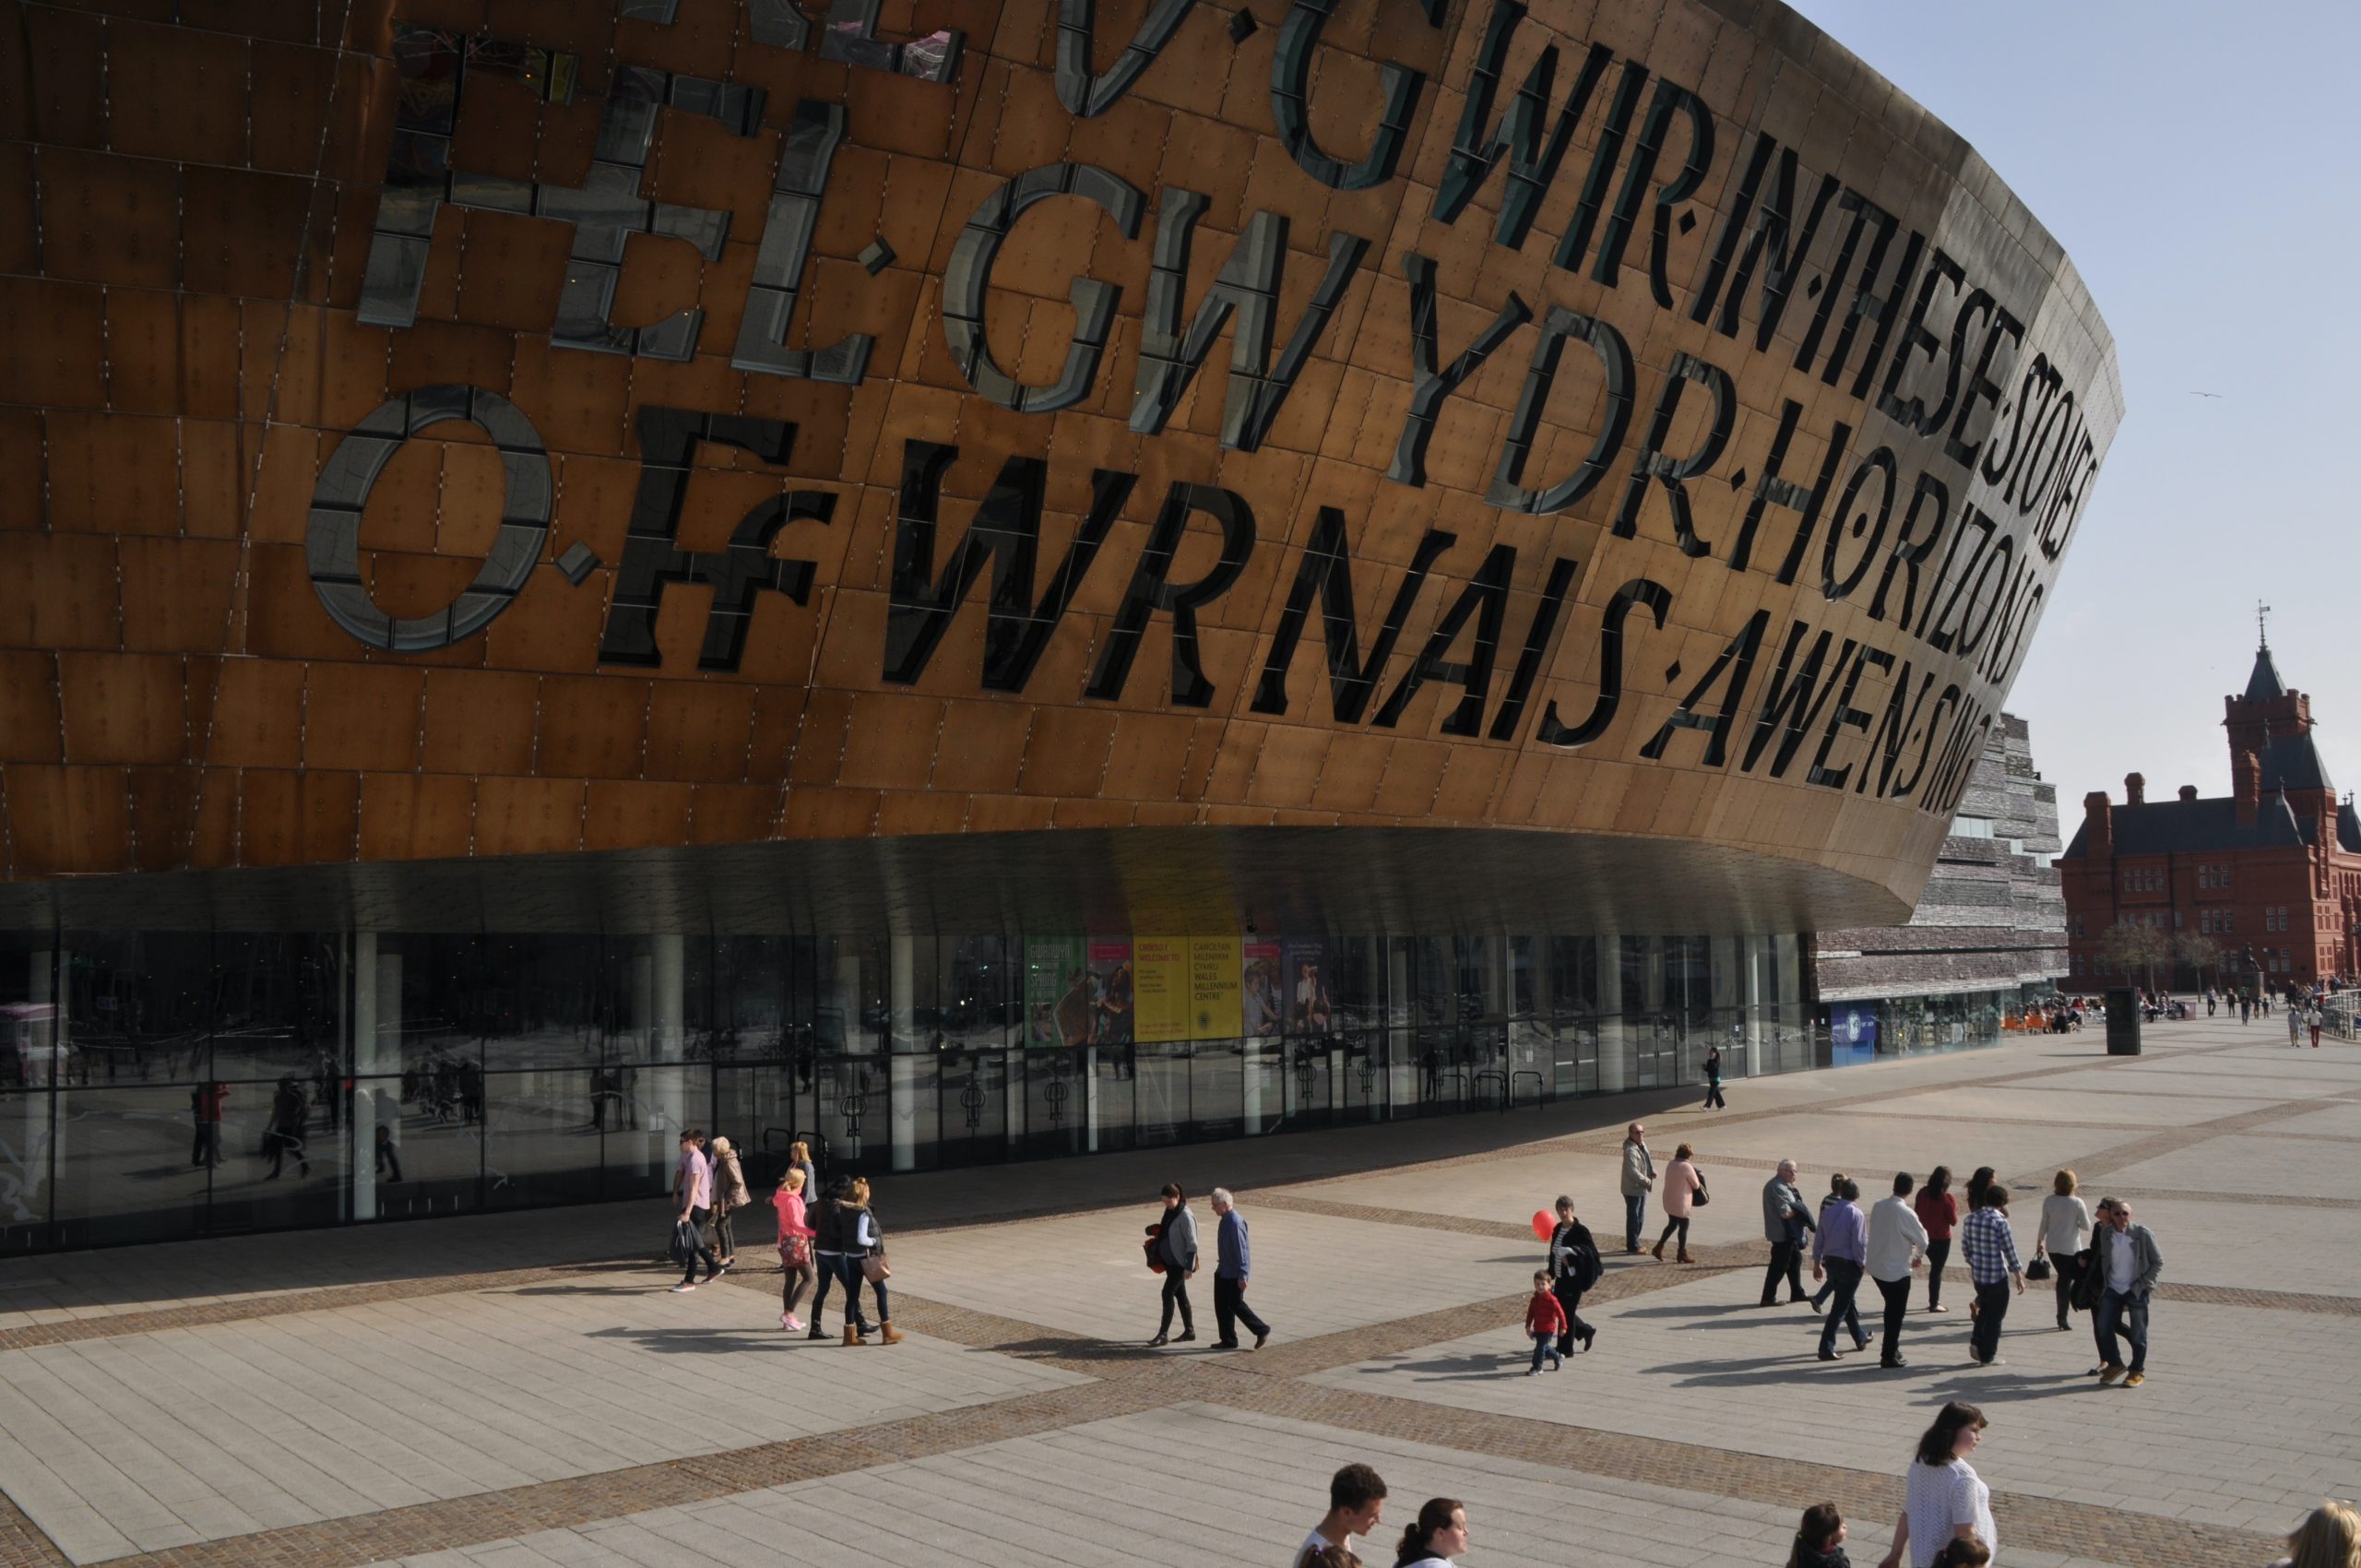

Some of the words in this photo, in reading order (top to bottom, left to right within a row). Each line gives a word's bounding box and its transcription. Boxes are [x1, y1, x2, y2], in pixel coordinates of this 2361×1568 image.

[1688, 130, 1841, 353] IN
[1794, 184, 2026, 471] THESE
[1982, 350, 2098, 564] STONES
[943, 162, 1738, 559] GWYDR
[1727, 398, 2045, 684] HORIZONS
[1638, 609, 1935, 800] AWEN
[1891, 683, 1992, 818] SING
[1193, 943, 1231, 952] CANOLFAN
[1138, 953, 1171, 962] WELCOME
[1172, 953, 1180, 961] TO
[1193, 962, 1218, 971] CYMRU
[1194, 972, 1217, 981] WALES
[1194, 981, 1238, 991] MILLENNIUM
[1194, 992, 1221, 1001] CENTRE
